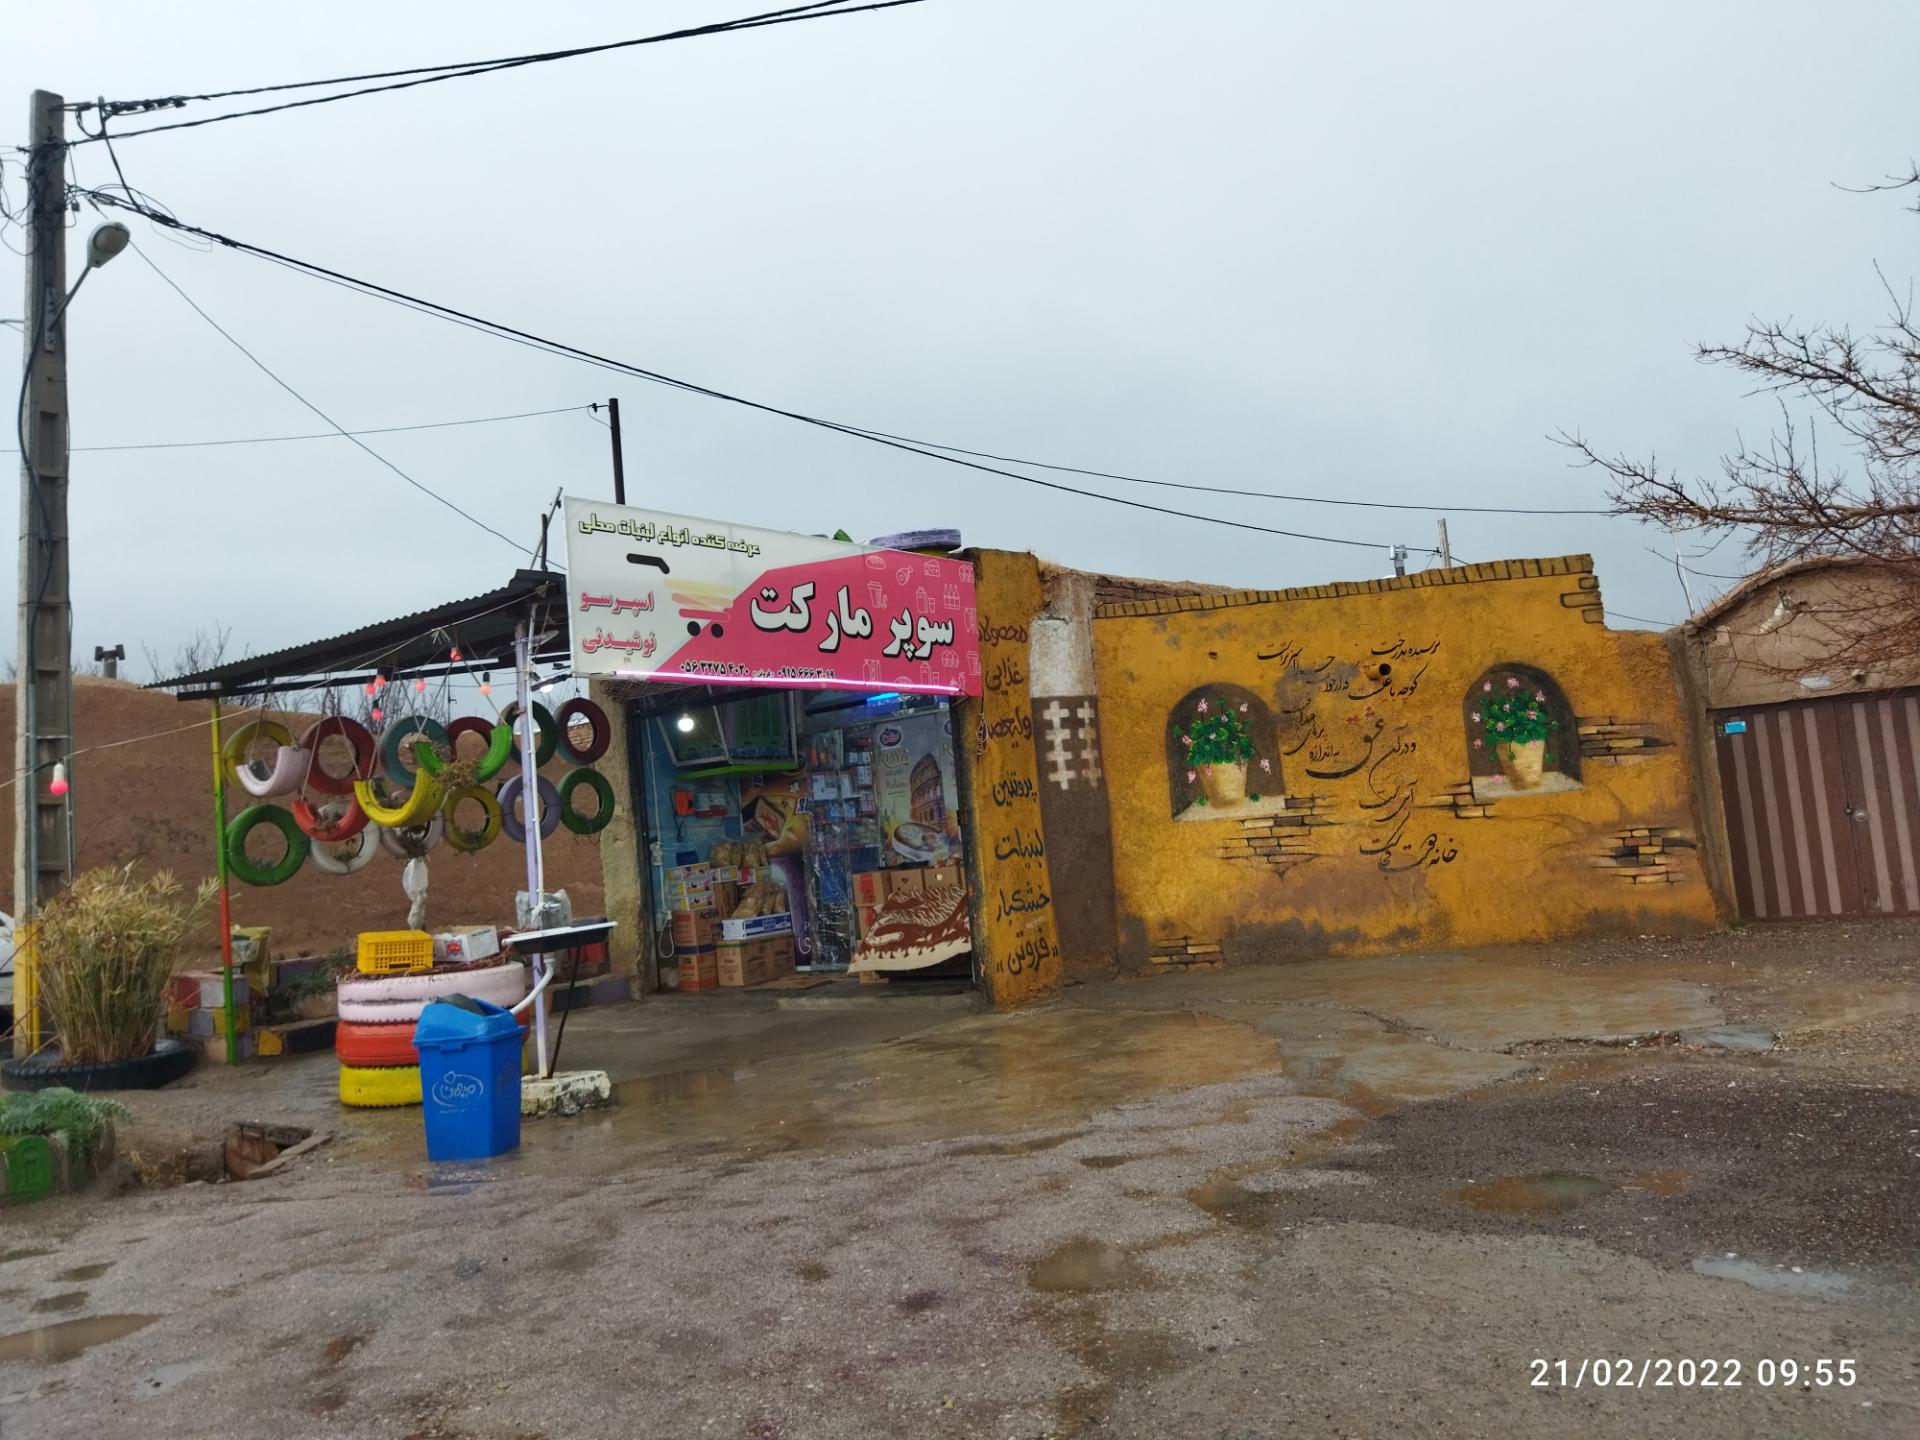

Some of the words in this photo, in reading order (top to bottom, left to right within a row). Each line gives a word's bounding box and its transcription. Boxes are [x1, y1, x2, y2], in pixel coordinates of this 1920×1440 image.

[578, 512, 616, 534] محلی
[617, 518, 656, 543] لبنیات
[656, 525, 690, 547] انواع
[691, 534, 725, 549] کننده
[727, 539, 761, 557] عرضه
[580, 590, 655, 618] اسپرسو
[582, 626, 657, 658] نوشیدنی
[882, 607, 955, 661] سوپر
[978, 615, 1028, 647] محصولا
[985, 657, 1025, 695] غذایی
[994, 826, 1045, 869] لبنیات
